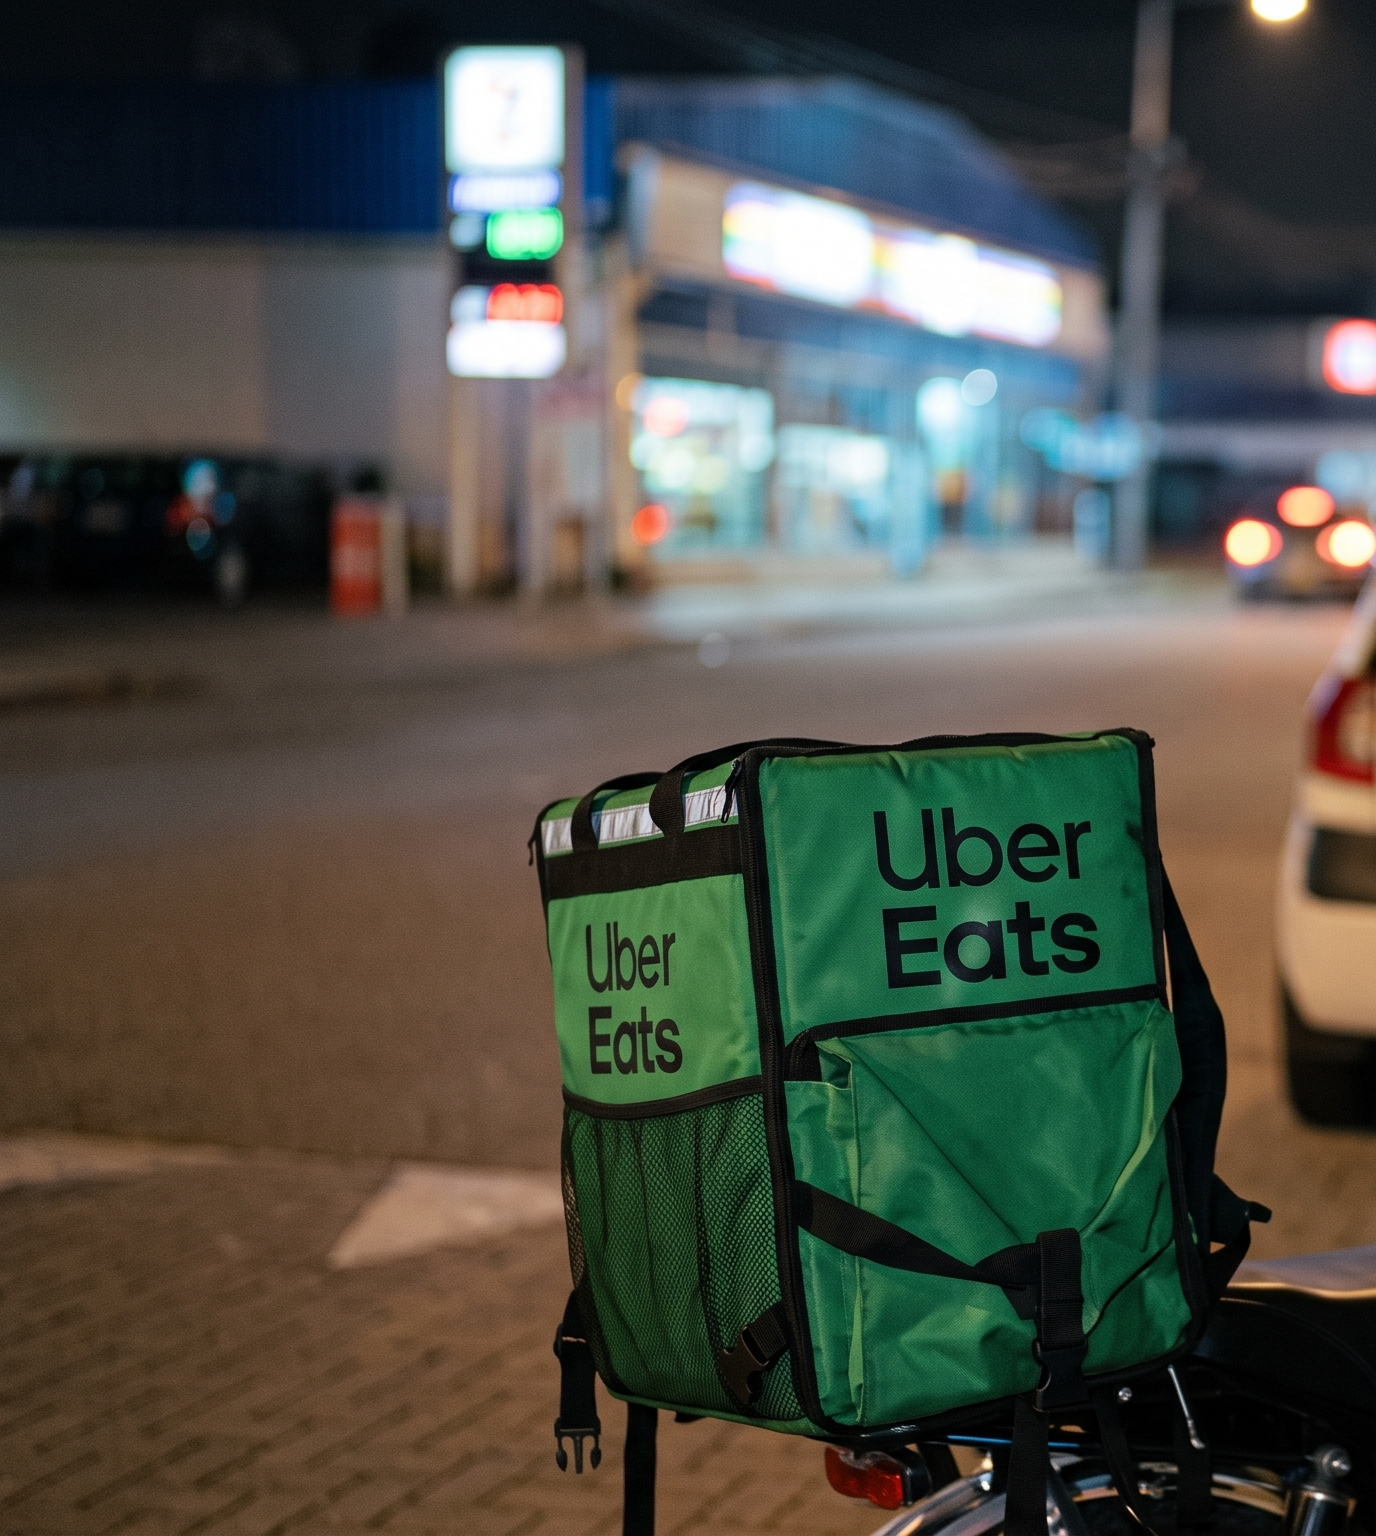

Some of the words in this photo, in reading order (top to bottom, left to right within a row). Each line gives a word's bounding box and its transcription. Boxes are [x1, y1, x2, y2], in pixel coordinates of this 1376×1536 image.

[873, 807, 1093, 892] Uber
[584, 920, 677, 994] Uber
[881, 900, 1101, 990] Eats
[587, 1005, 684, 1076] Eats
